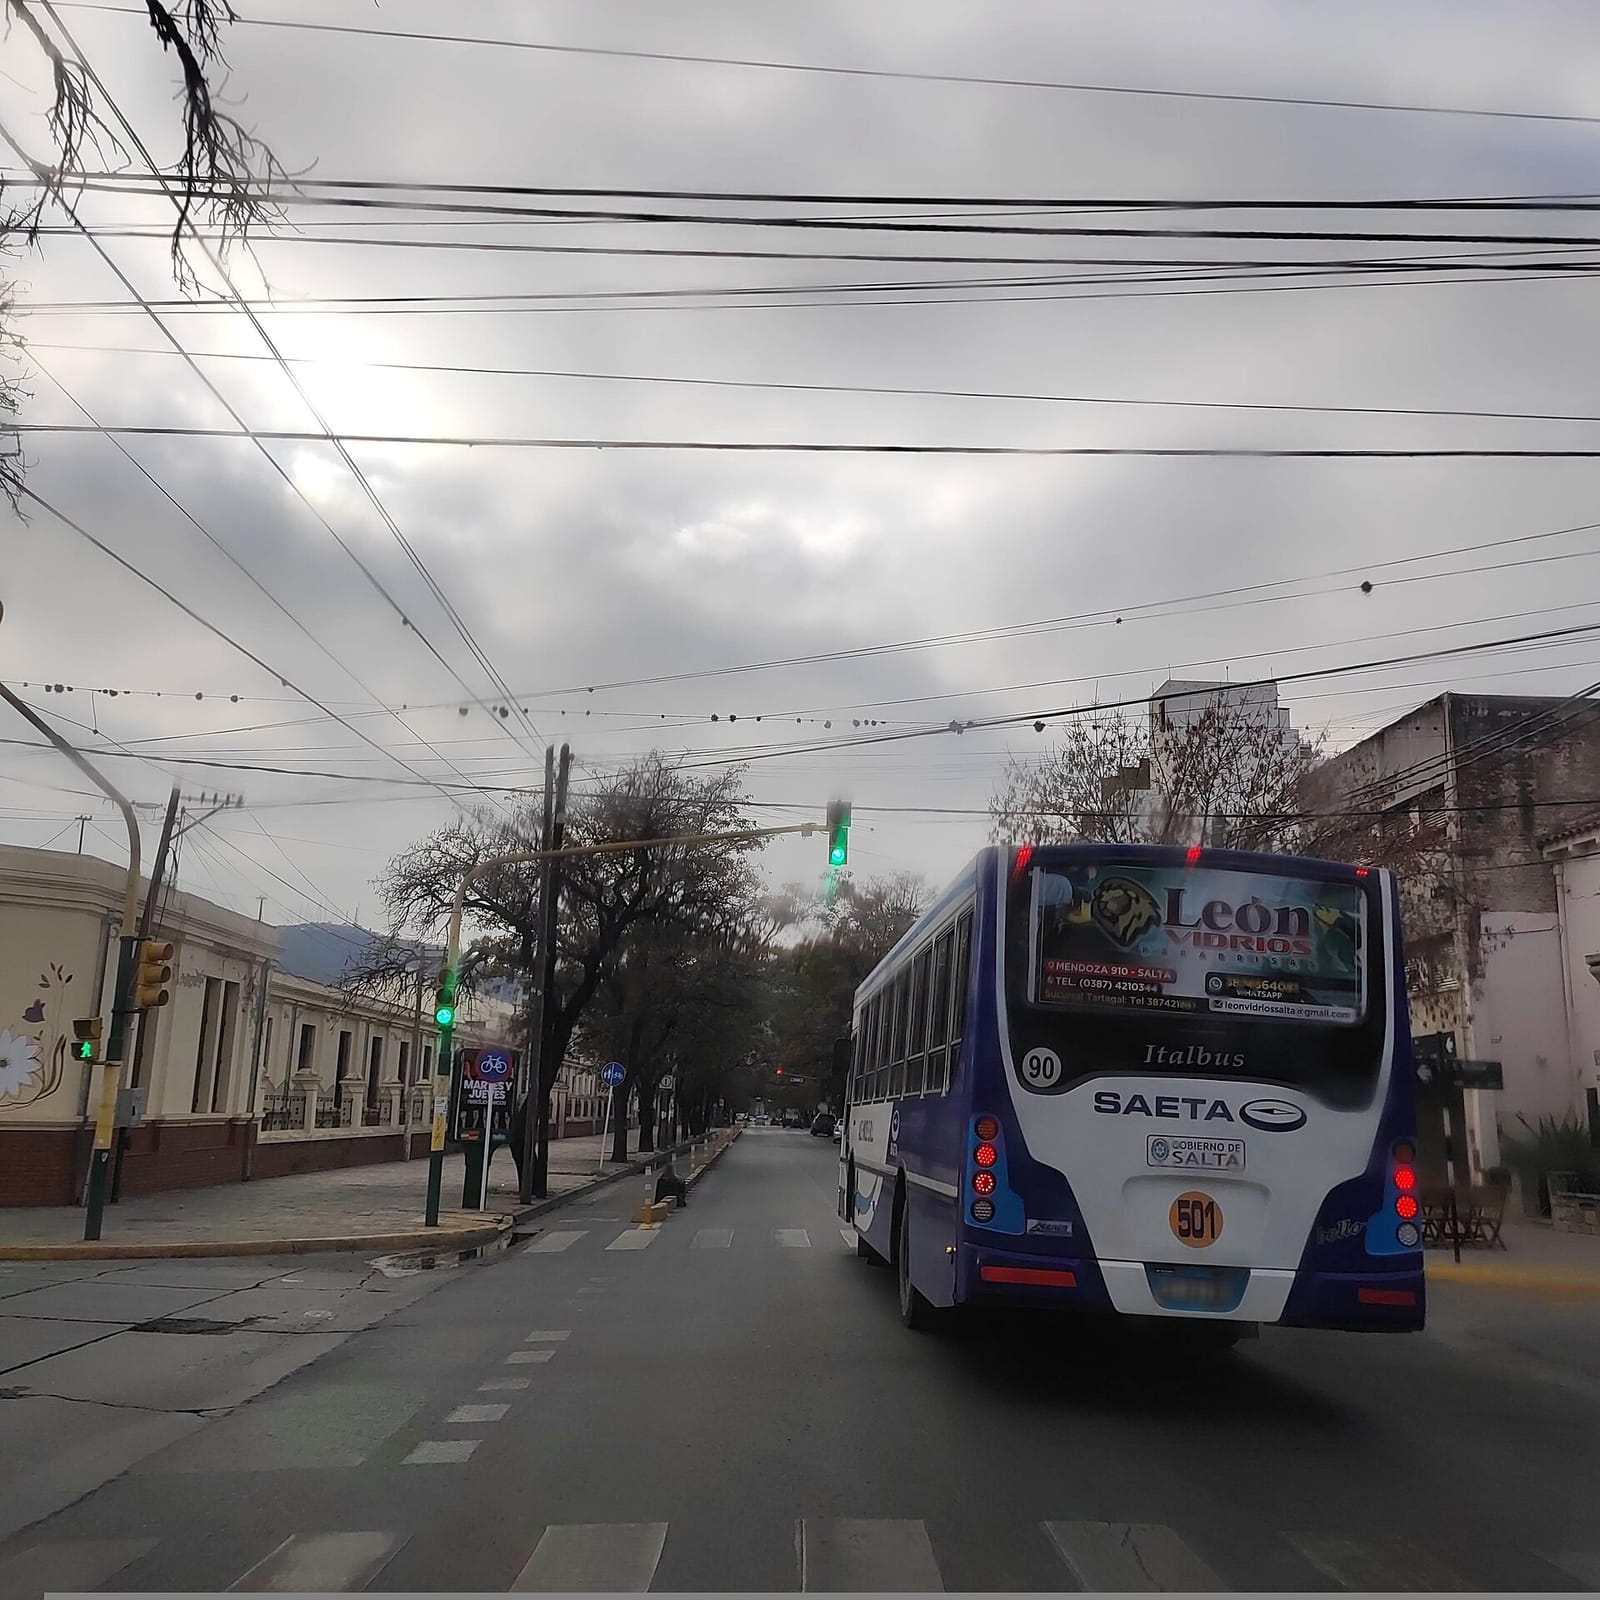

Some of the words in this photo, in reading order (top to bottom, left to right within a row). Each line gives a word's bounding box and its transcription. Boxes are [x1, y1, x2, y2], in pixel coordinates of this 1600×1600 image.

[1163, 888, 1311, 937] León
[1166, 930, 1312, 956] VIDRIOS
[1056, 962, 1108, 975] MENDOZA
[1111, 966, 1129, 976] 910
[1137, 968, 1172, 980] SALTA
[1056, 977, 1076, 987] TEL.
[1079, 979, 1113, 991] (0387)
[1130, 996, 1145, 1006] Tel
[1236, 990, 1283, 1000] WHATSAPP
[1143, 1044, 1245, 1067] Italbus
[1028, 1054, 1055, 1080] 90
[464, 1080, 505, 1090] MARES
[505, 1081, 513, 1092] Y
[468, 1090, 506, 1099] JUEES
[1094, 1091, 1235, 1122] SAETA
[1173, 1140, 1225, 1152] GOBIERNO
[1228, 1143, 1241, 1153] DE
[1172, 1151, 1240, 1167] SALTA
[1177, 1199, 1216, 1240] 501
